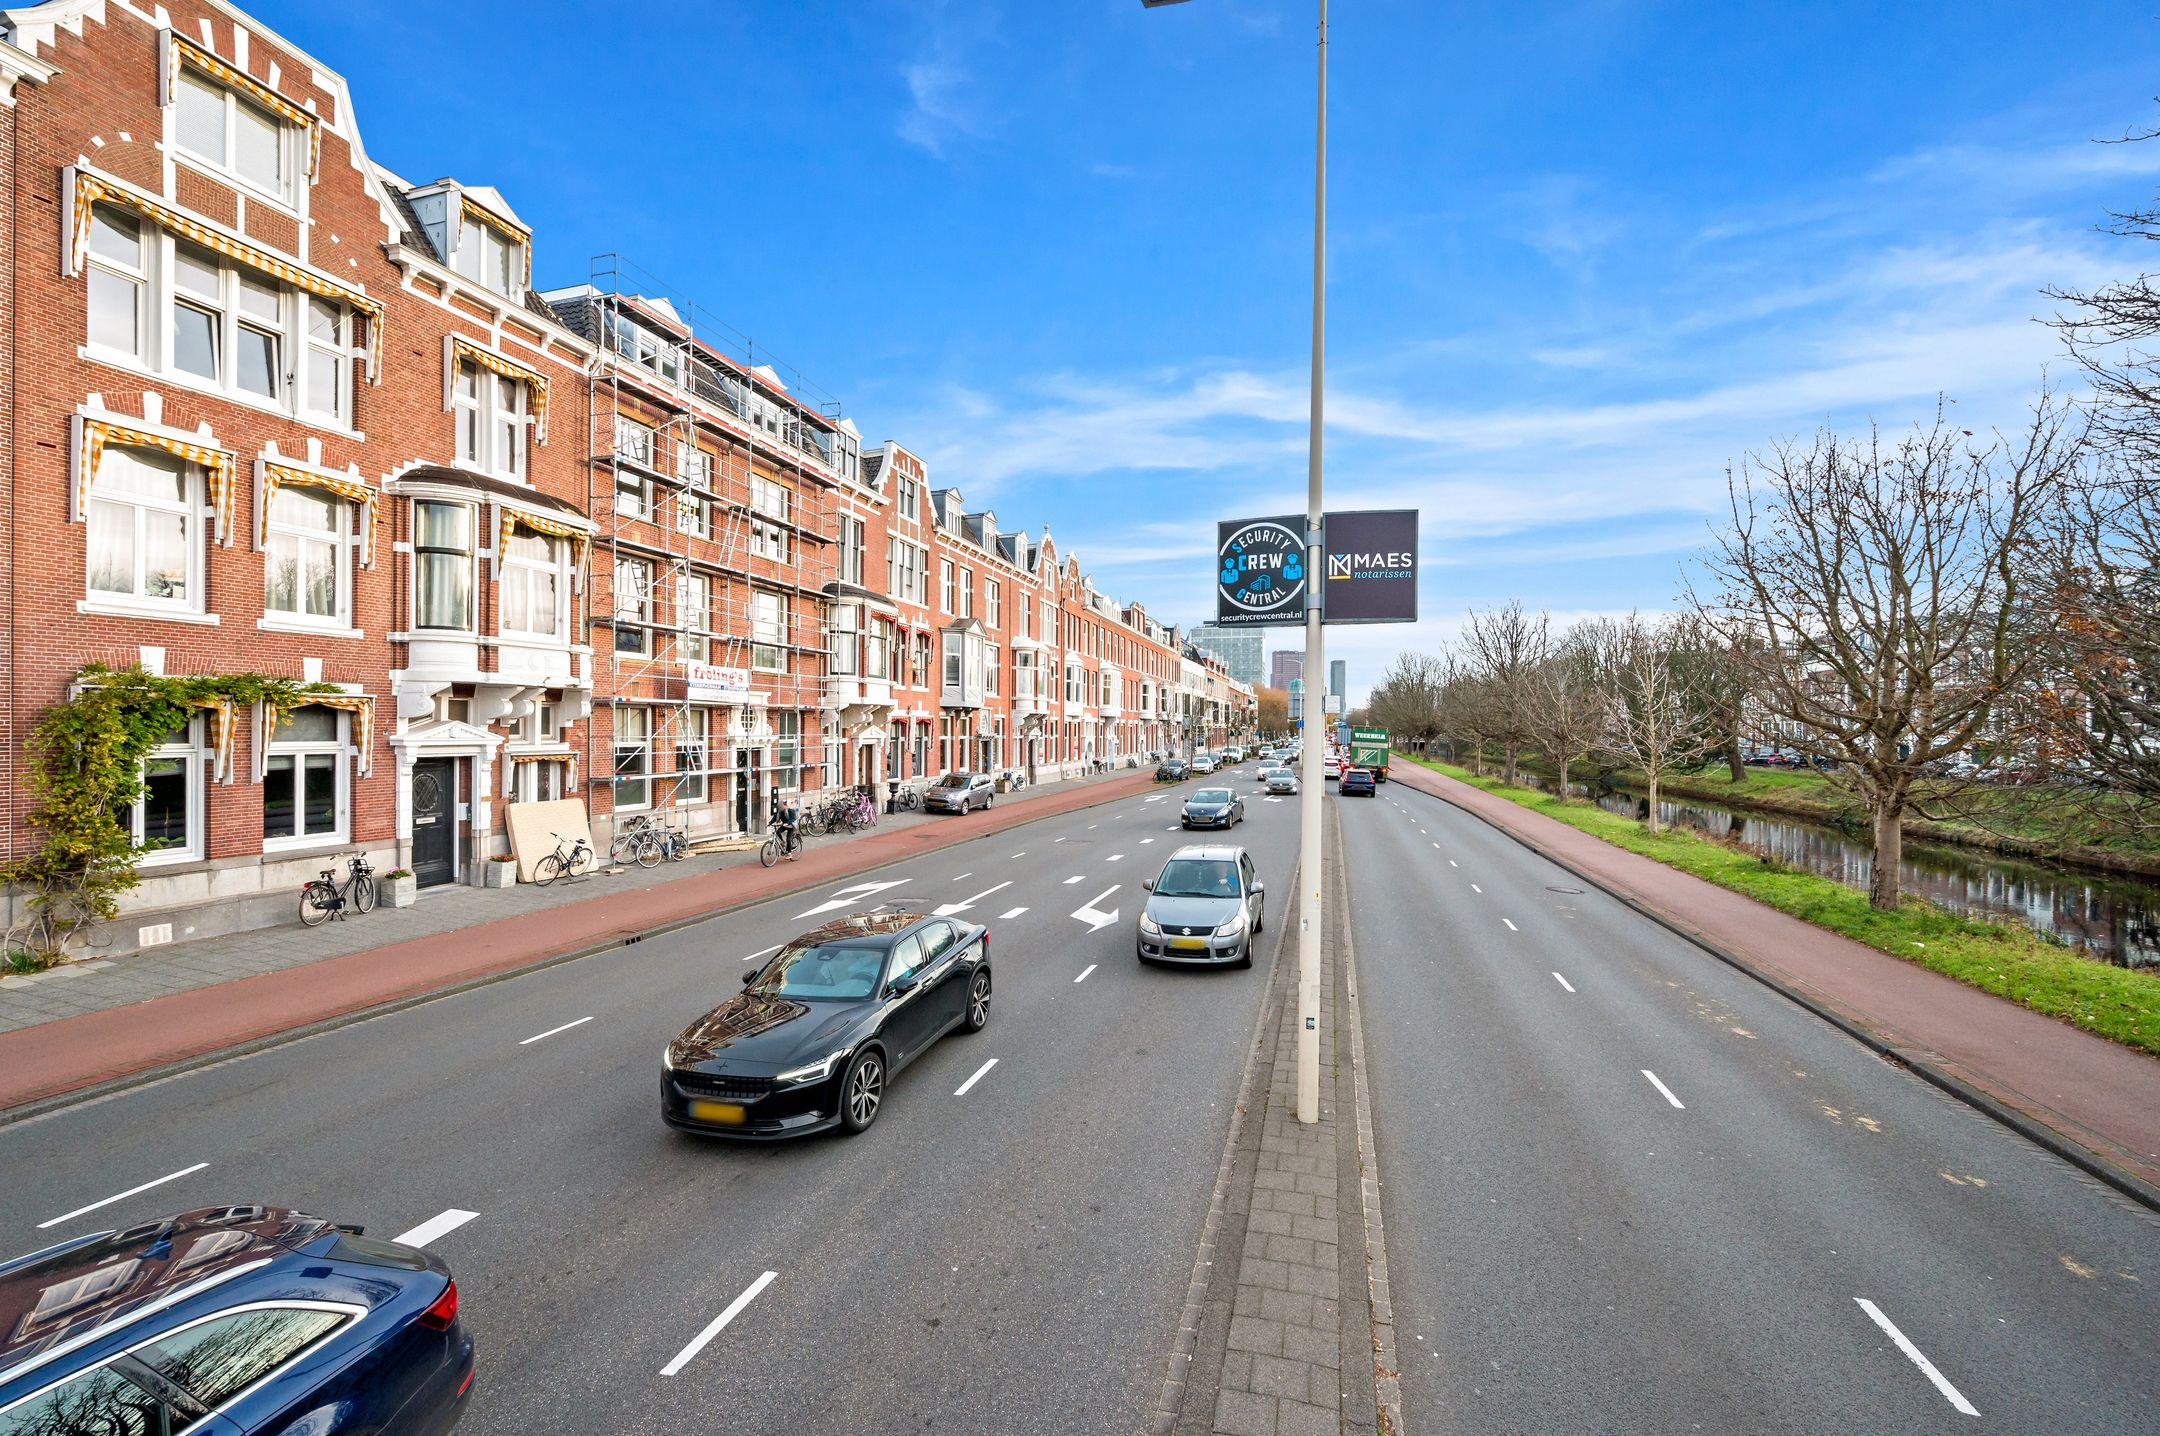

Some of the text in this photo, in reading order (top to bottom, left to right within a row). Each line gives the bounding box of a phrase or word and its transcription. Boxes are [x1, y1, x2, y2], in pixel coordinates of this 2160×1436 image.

[1232, 529, 1292, 553] SECURITY
[1238, 553, 1283, 571] CREW
[1354, 552, 1412, 568] MAES
[1354, 569, 1412, 579] notarissen
[1236, 587, 1286, 605] CENTRAL
[1221, 611, 1302, 622] securitycrewcentral.nl
